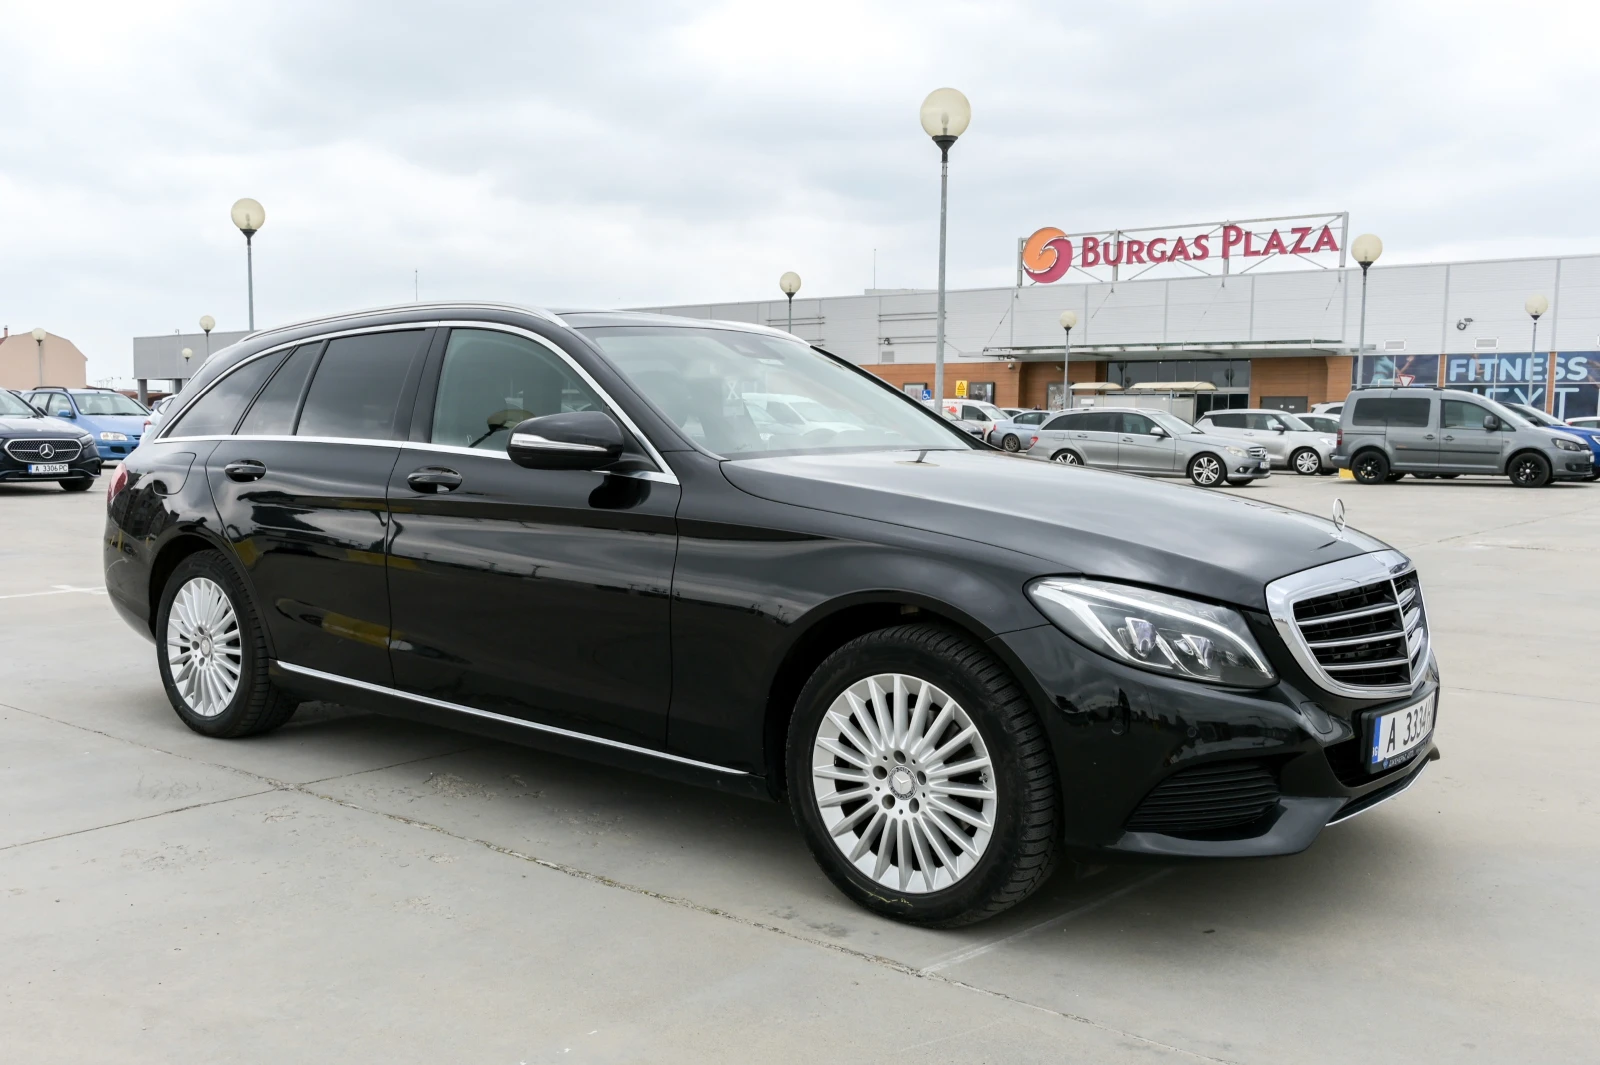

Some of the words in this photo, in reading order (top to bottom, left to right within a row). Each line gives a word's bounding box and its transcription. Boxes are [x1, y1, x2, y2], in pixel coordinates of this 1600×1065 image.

[1081, 234, 1209, 268] BURGAS
[1221, 224, 1340, 260] PLAZA
[1450, 356, 1588, 382] FITNESS
[1386, 717, 1396, 753] A
